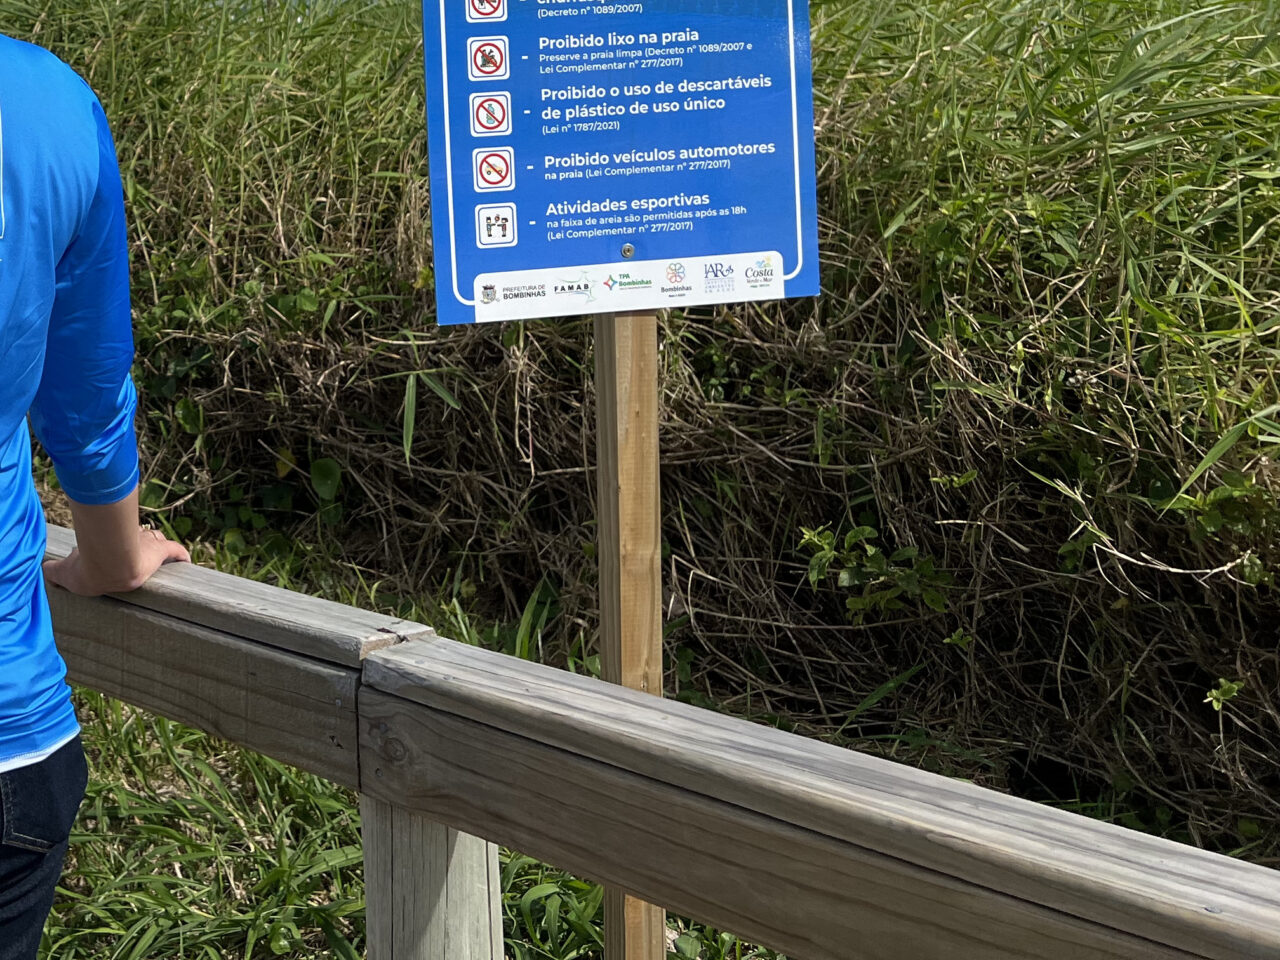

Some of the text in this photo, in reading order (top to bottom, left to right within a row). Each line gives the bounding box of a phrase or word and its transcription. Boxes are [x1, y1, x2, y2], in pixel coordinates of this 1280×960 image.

[537, 8, 578, 19] (Decreto
[592, 3, 643, 14] 1089/2007)
[539, 27, 699, 49] Proibido lixo na praia
[539, 53, 580, 62] Preserve
[590, 52, 614, 61] praia
[616, 50, 642, 58] limpa
[644, 47, 684, 57] (Decreto
[698, 42, 745, 53] 1089/2007
[539, 64, 553, 74] Lei
[555, 62, 627, 73] Complementar
[640, 57, 683, 68] 277/2017)
[540, 73, 772, 101] Proibido o uso de descartáveis
[541, 96, 726, 121] de plástico de uso único
[542, 124, 559, 135] (Lei
[573, 120, 620, 131] 1787/2021)
[544, 142, 776, 168] Proibido veículos automotores
[544, 172, 557, 180] na
[559, 169, 583, 181] praia
[585, 167, 602, 179] (Lei
[604, 164, 674, 176] Complementar
[688, 159, 730, 170] 277/2017)
[545, 192, 710, 216] Atividades esportivas
[560, 218, 582, 227] faixa
[585, 217, 596, 225] de
[599, 216, 622, 224] areia
[624, 214, 640, 222] são
[642, 210, 693, 223] permitidas
[695, 208, 718, 218] após
[718, 208, 730, 216] as
[730, 205, 746, 214] 18h
[547, 230, 564, 241] (Lei
[566, 226, 636, 238] Complementar
[650, 221, 693, 232] 277/2017)
[745, 266, 774, 278] Costa
[502, 285, 537, 293] PREFEITURA
[554, 284, 590, 292] FAMAB
[618, 279, 652, 287] Bombinhas
[660, 285, 692, 293] Bombinhas
[503, 291, 546, 300] BOMBINHAS
